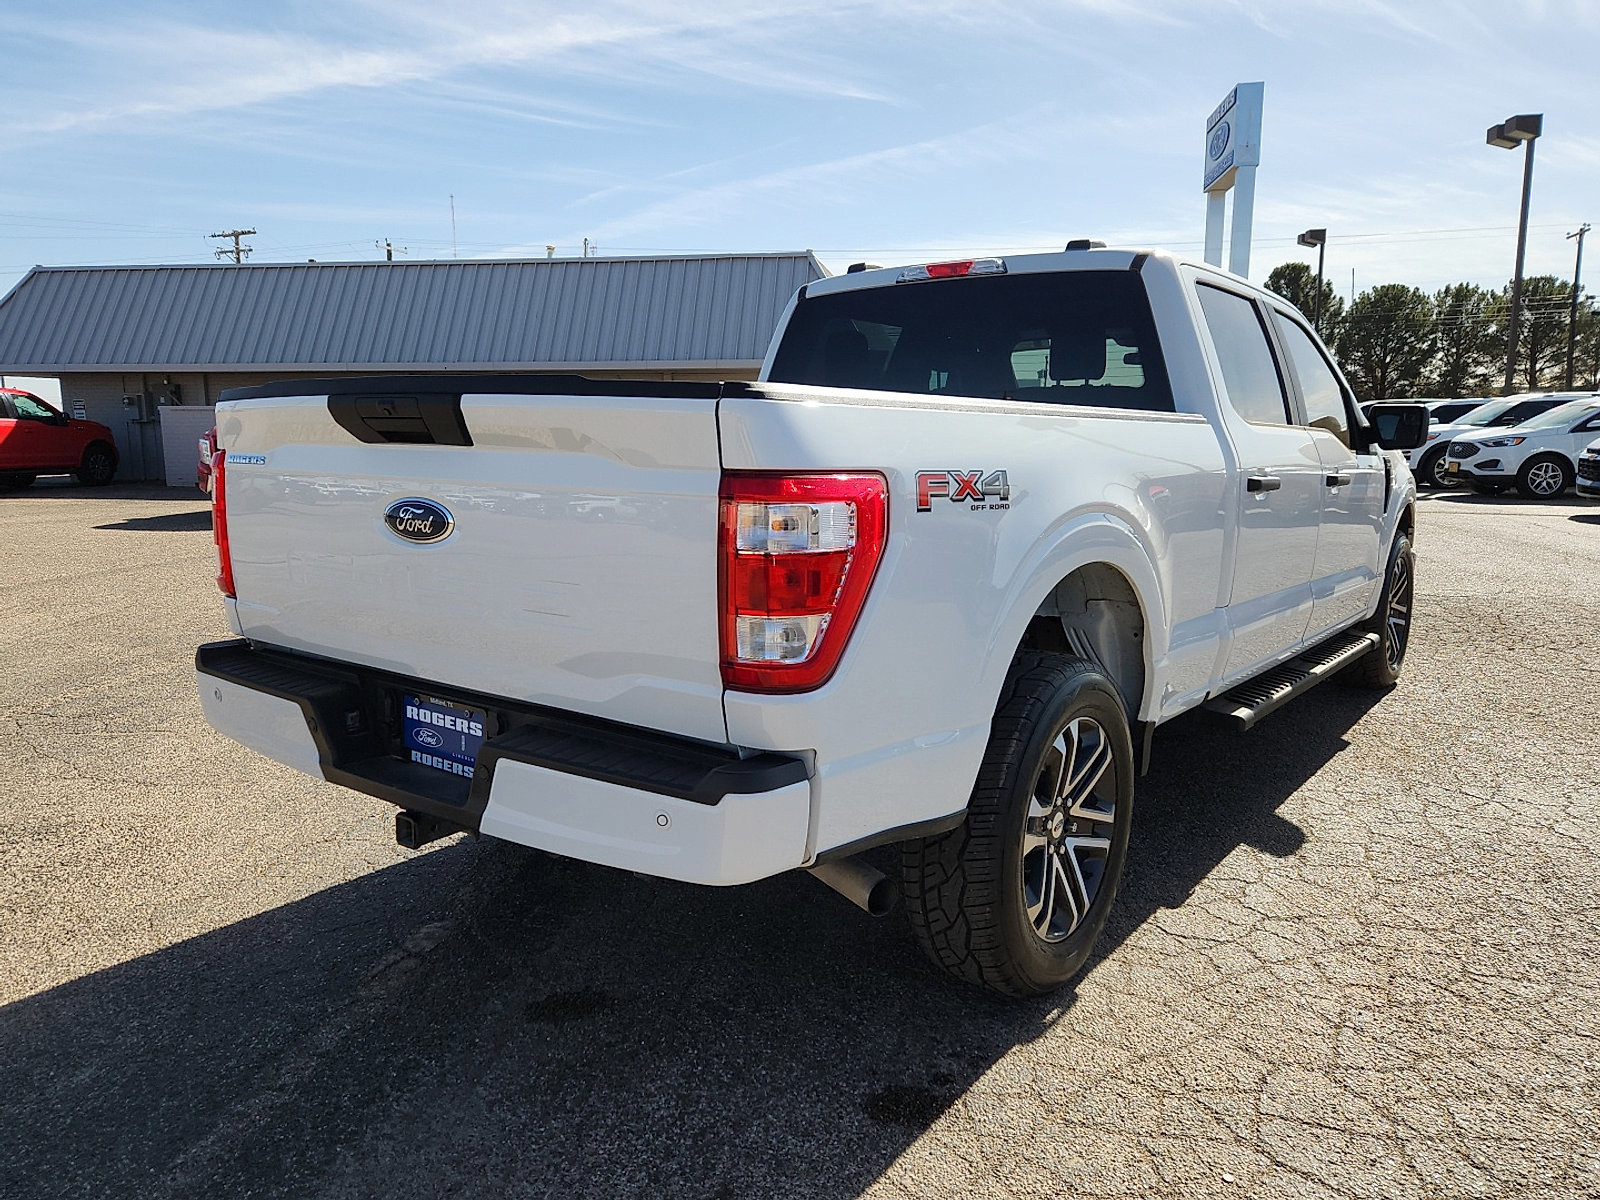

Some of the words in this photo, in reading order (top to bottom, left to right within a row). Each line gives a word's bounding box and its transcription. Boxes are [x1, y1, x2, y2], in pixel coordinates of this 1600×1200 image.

[915, 470, 1010, 512] FX4
[396, 506, 434, 533] Ford
[989, 503, 1010, 511] ROAD
[406, 705, 483, 737] ROGERS
[418, 729, 438, 746] Ford
[411, 750, 475, 779] ROGERS
